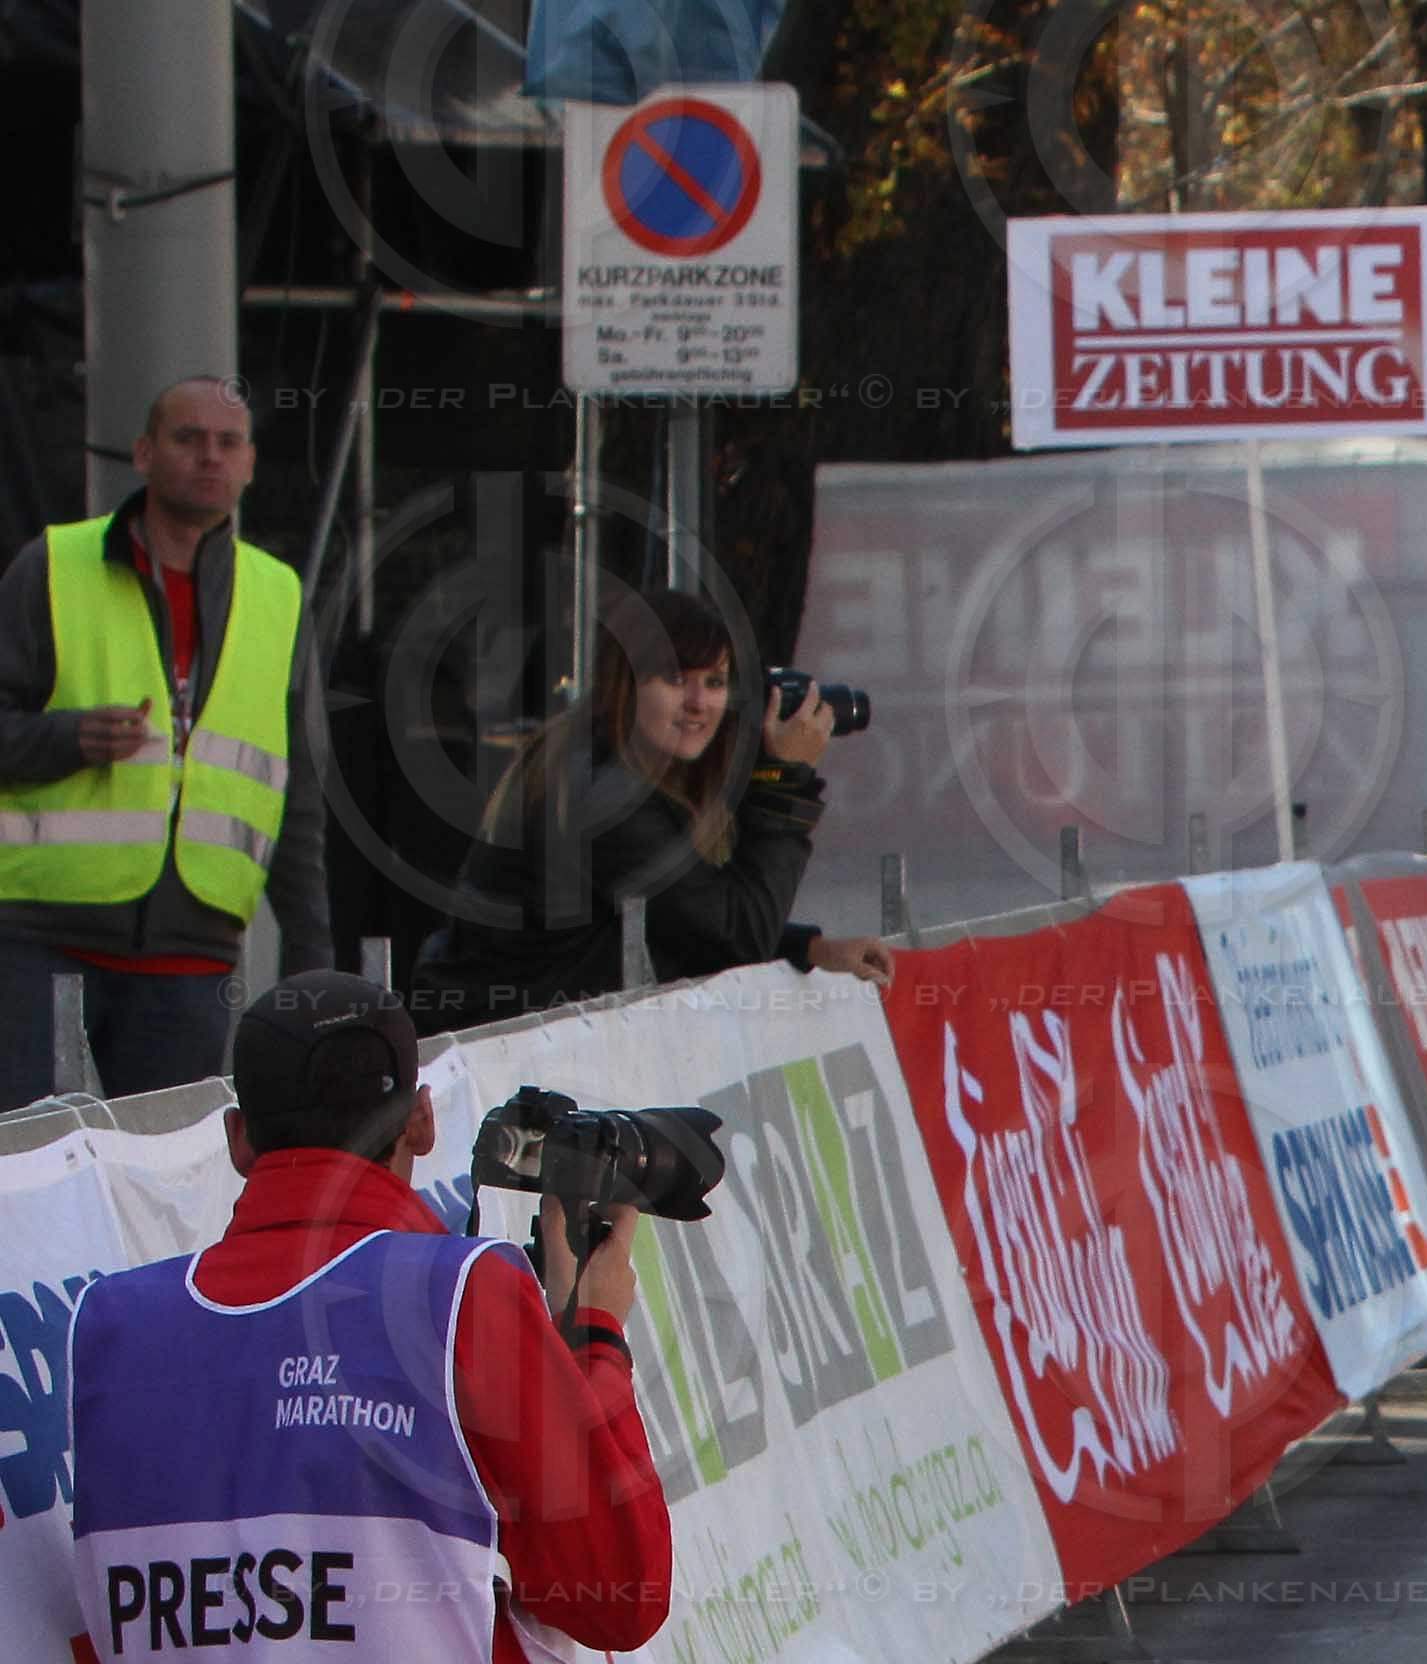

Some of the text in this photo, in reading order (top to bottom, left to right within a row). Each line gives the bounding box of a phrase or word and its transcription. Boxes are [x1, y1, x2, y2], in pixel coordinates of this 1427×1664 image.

[578, 265, 784, 287] KURZPARKZONE
[1072, 244, 1403, 331] KLEINE
[1072, 345, 1408, 412] ZEITUNG
[279, 1355, 339, 1389] GRAZ
[275, 1396, 416, 1438] MARATHON
[107, 1551, 356, 1655] PRESSE
